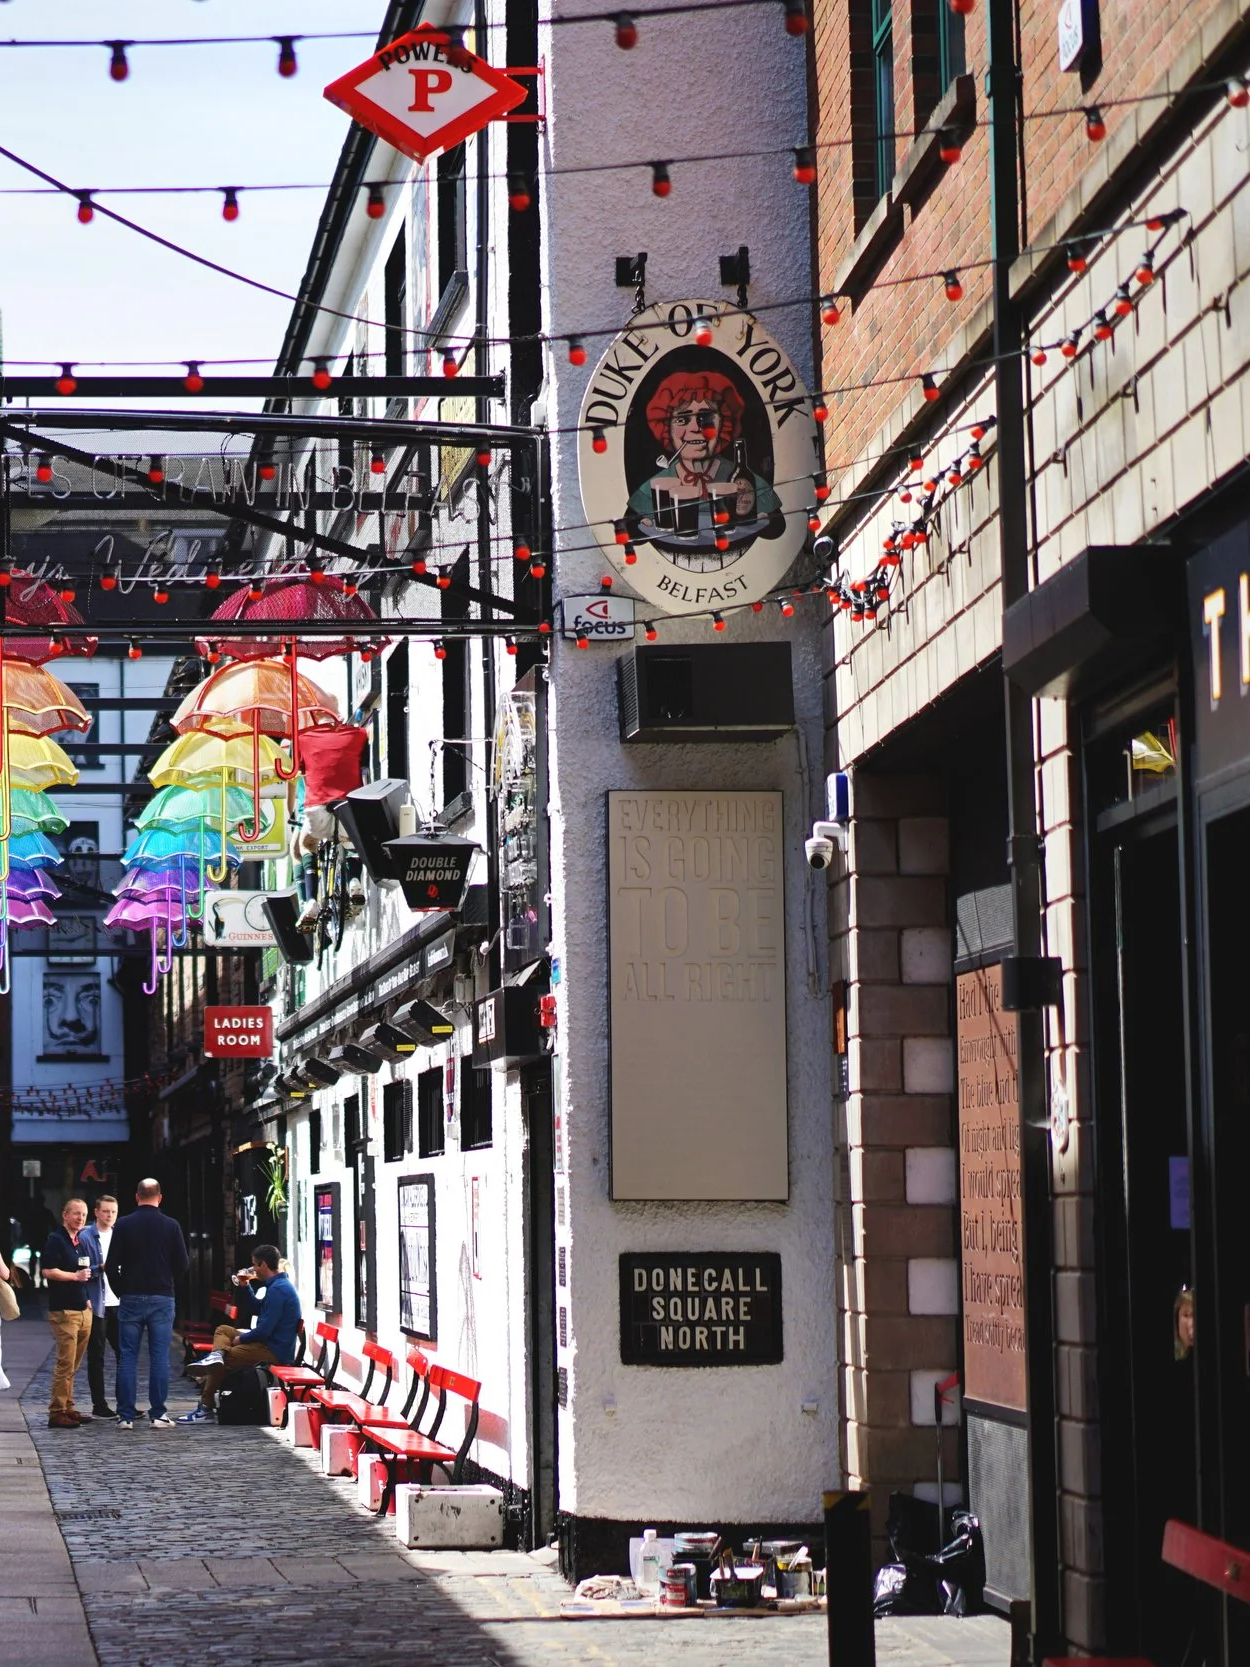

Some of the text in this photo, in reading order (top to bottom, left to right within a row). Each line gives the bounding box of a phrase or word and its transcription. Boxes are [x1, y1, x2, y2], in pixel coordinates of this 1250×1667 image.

[407, 69, 453, 112] P
[585, 331, 659, 427] DUKE
[736, 324, 810, 429] YORK
[656, 573, 749, 604] BELFAST
[573, 615, 627, 635] focus
[618, 800, 776, 833] EVERYTHING
[405, 869, 461, 881] DIAMOND
[410, 857, 457, 869] DOUBLE
[619, 836, 777, 884] IS GOING
[228, 932, 275, 941] GUINNES
[618, 886, 777, 959] TO BE
[623, 963, 777, 1002] ALL RIGHT
[959, 979, 977, 1020] Had
[985, 975, 999, 1014] the
[214, 1018, 264, 1029] LADIES
[218, 1034, 261, 1046] ROOM
[960, 1025, 1017, 1067] Enwrought with
[960, 1077, 975, 1109] The
[976, 1074, 993, 1108] blue
[995, 1070, 1011, 1105] and
[961, 1116, 1020, 1159] Of night and lig
[967, 1161, 994, 1199] would
[996, 1168, 1022, 1207] sprea
[963, 1209, 1018, 1264] But I, being
[969, 1261, 992, 1305] have
[995, 1272, 1023, 1316] sprea
[652, 1297, 751, 1321] SQUARE
[660, 1326, 745, 1350] NORTH
[966, 1314, 984, 1345] Tread
[985, 1317, 1004, 1354] softly
